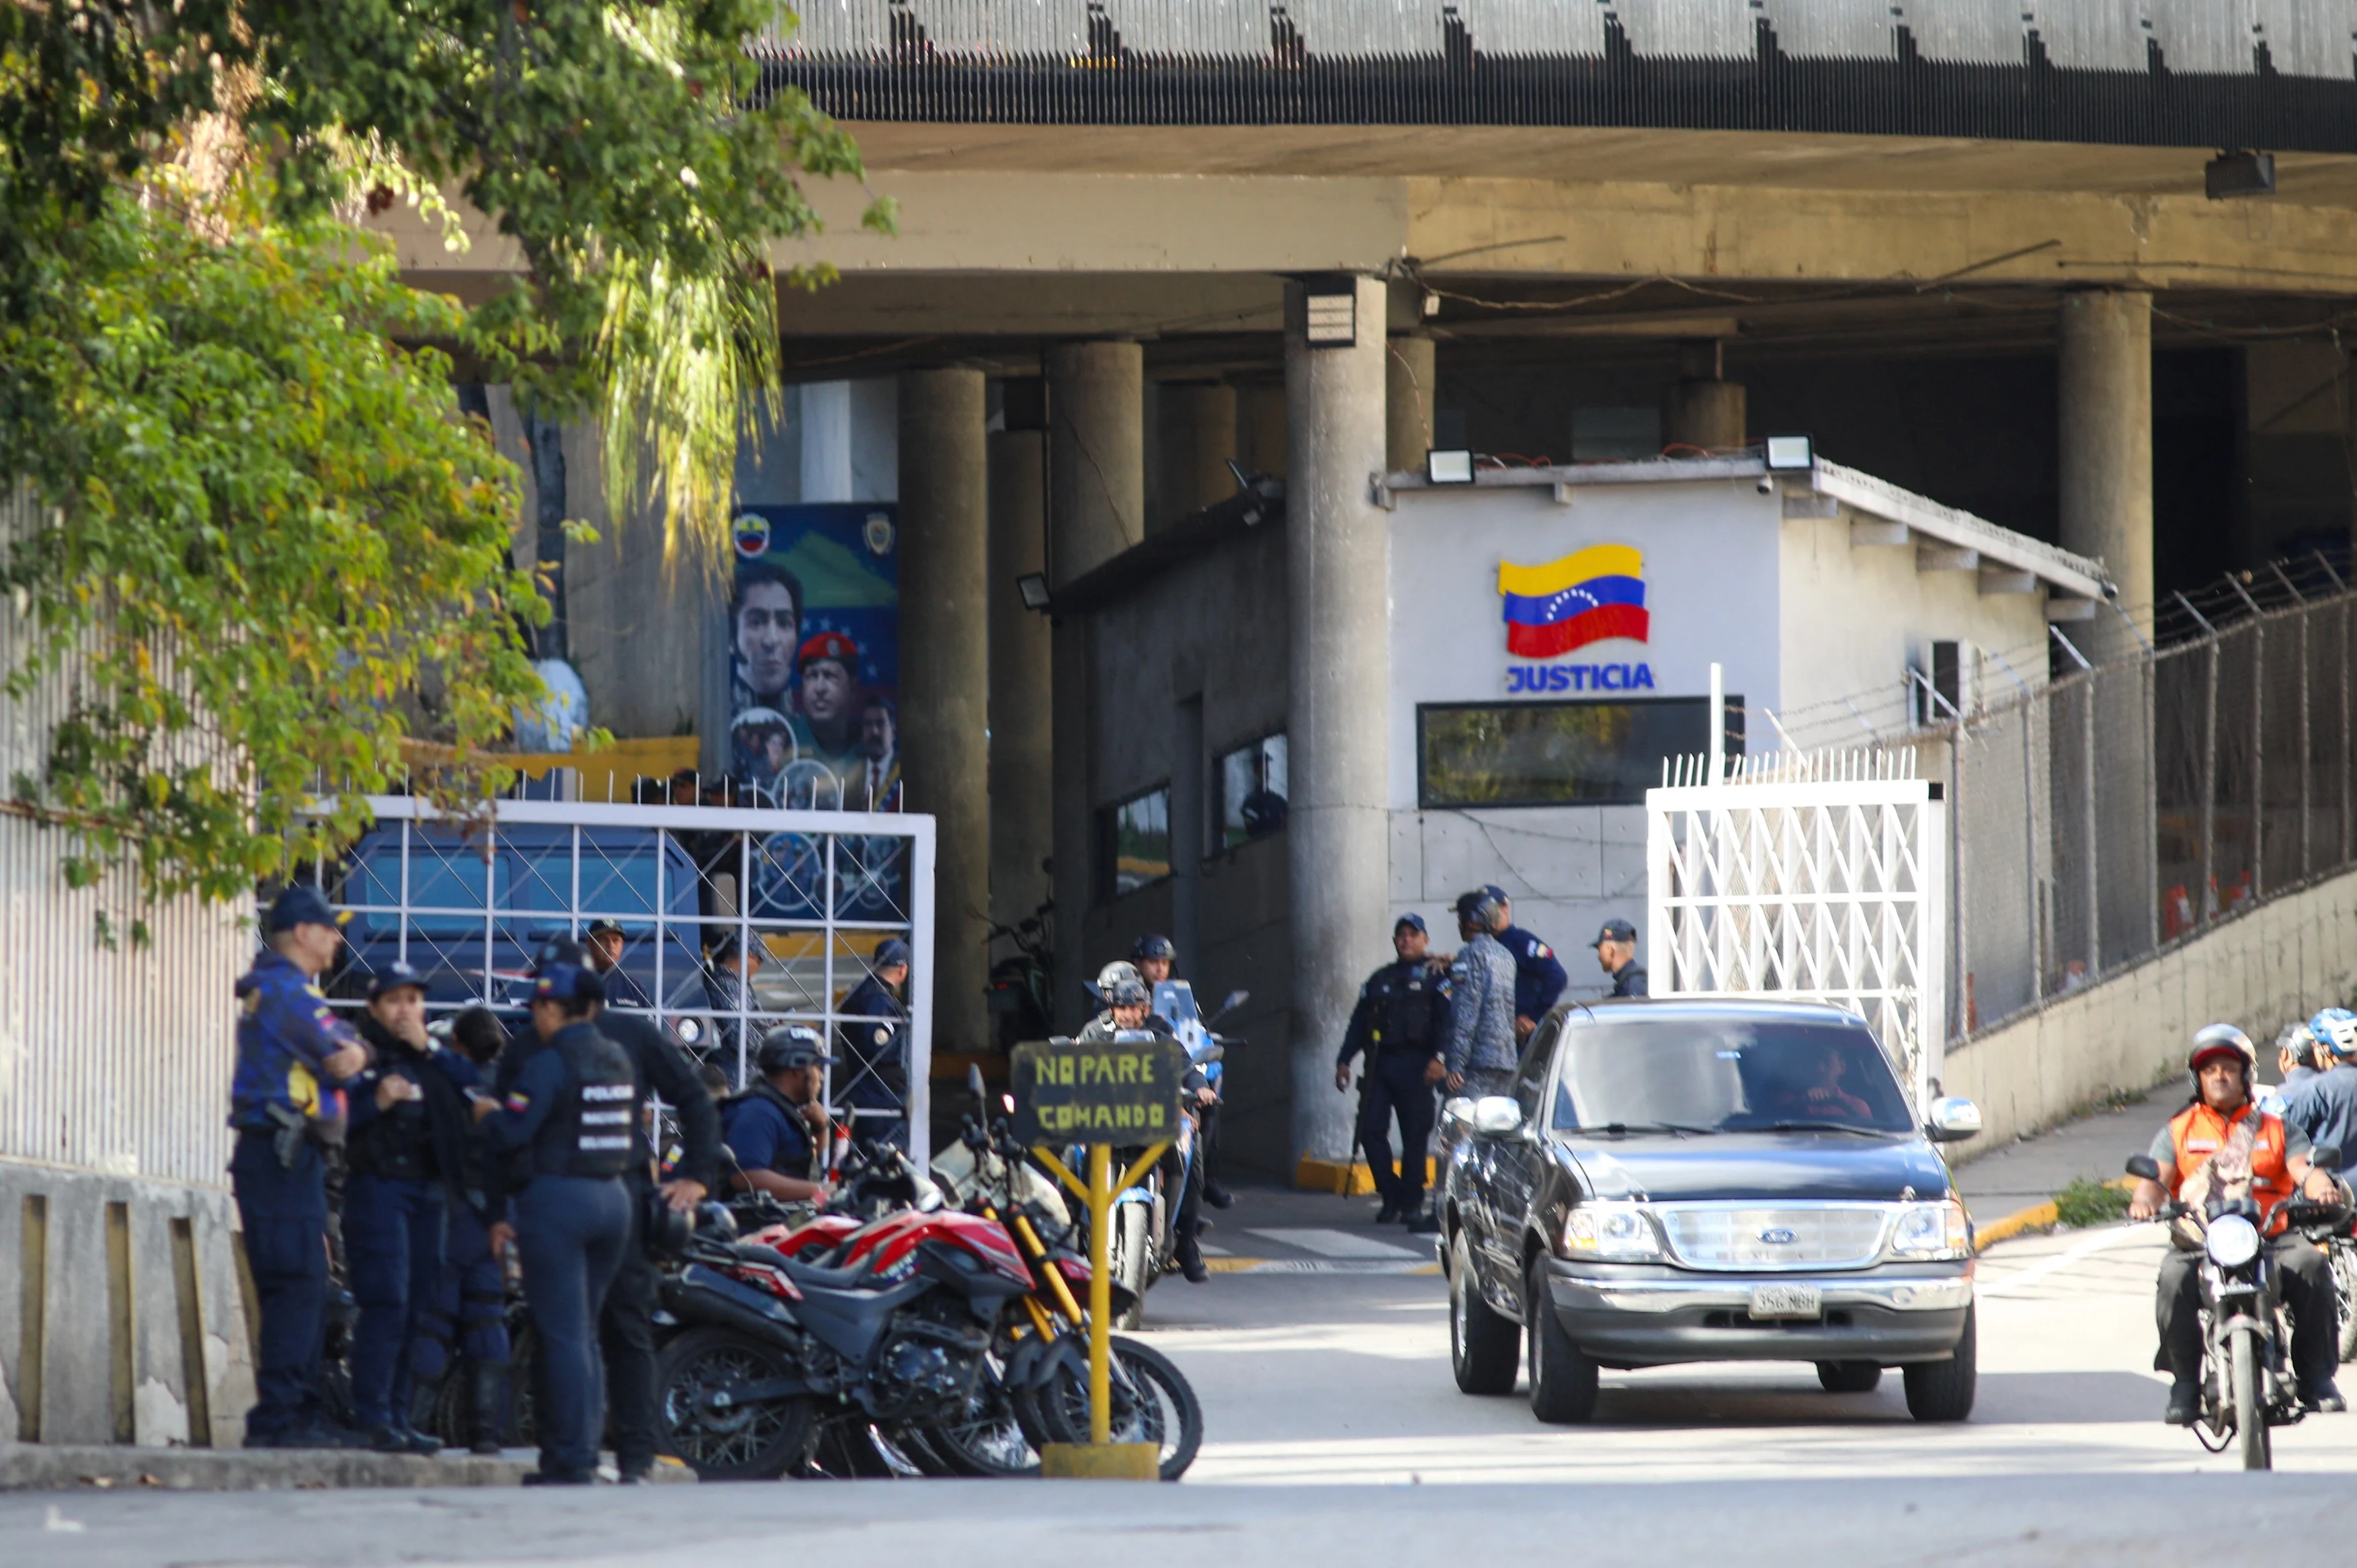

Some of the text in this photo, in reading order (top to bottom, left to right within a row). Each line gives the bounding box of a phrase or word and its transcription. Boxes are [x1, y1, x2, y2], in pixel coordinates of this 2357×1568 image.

[1507, 663, 1655, 694] JUSTICIA
[1036, 1053, 1155, 1085] NO PARE
[1038, 1103, 1164, 1130] COMANDO
